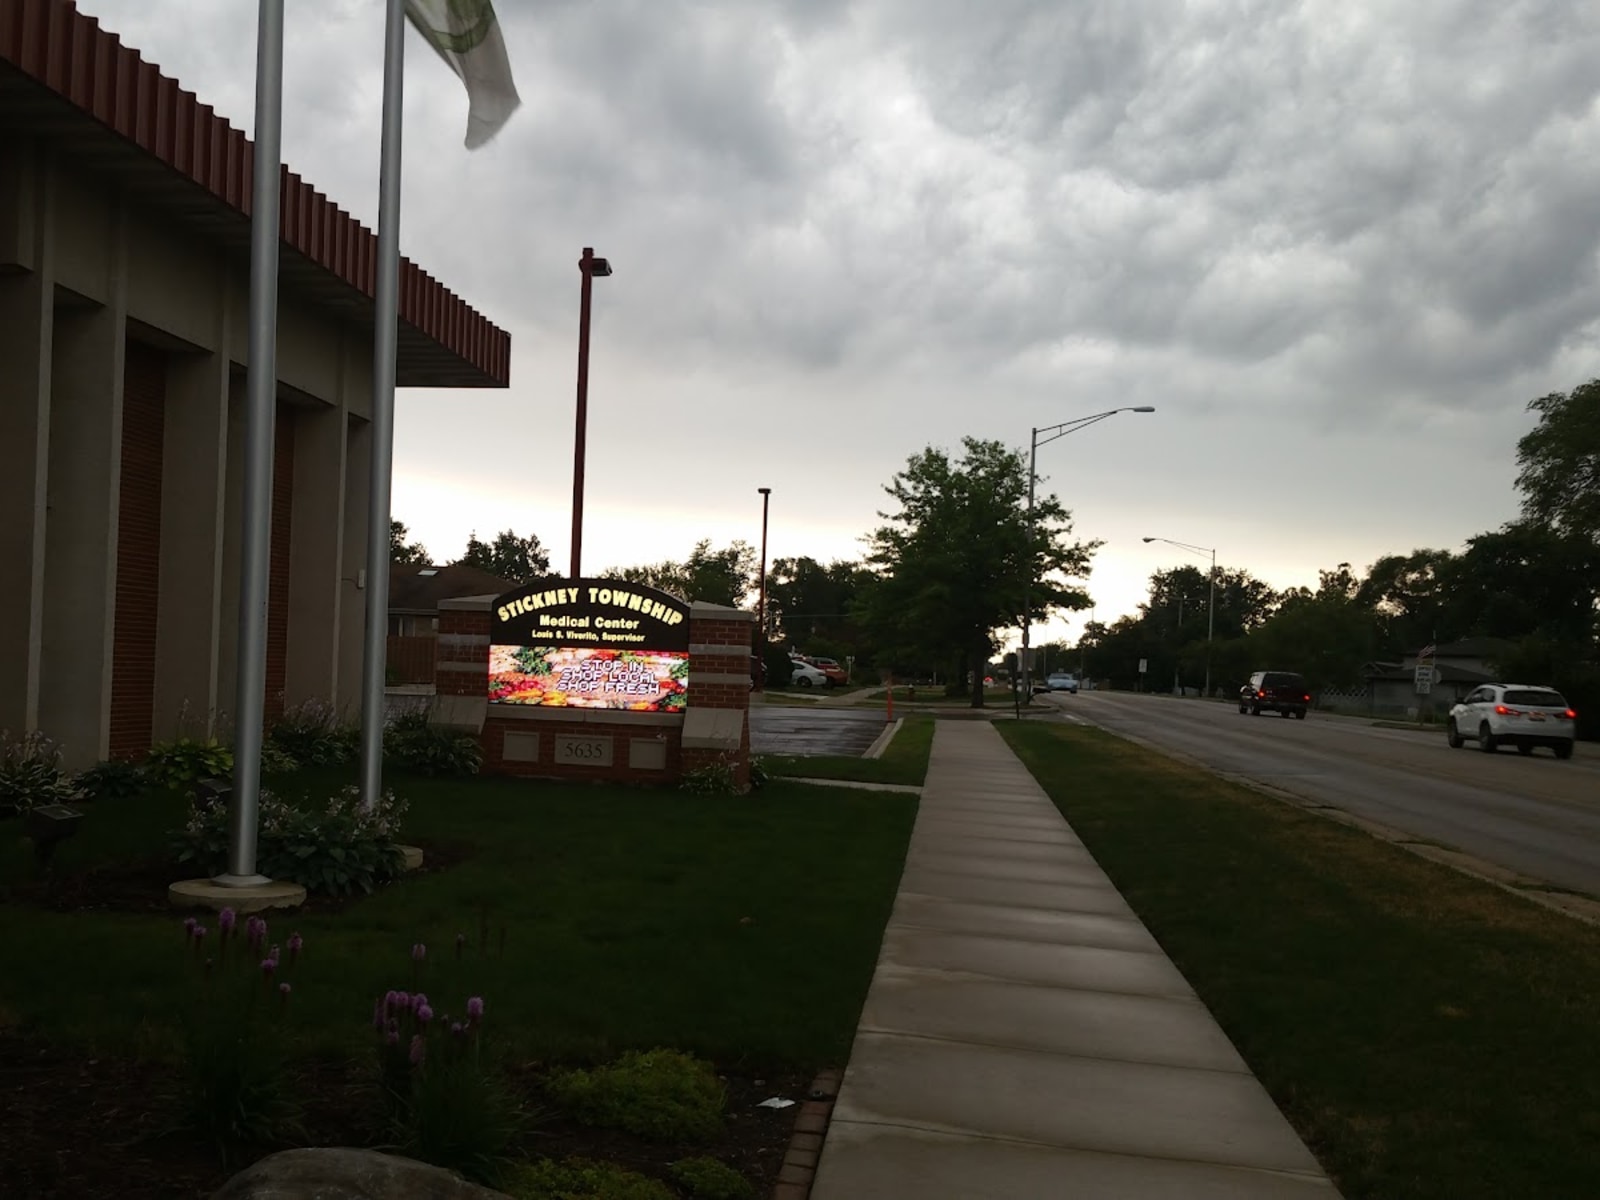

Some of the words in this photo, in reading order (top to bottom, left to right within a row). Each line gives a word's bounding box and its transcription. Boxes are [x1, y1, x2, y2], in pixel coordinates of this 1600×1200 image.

[497, 587, 579, 622] STICKNEY
[588, 587, 684, 627] TOWNSHIP
[539, 615, 590, 628] Medical
[594, 616, 640, 629] Center
[532, 629, 553, 639] Louis
[601, 632, 645, 643] Supervisor
[580, 659, 623, 672] STOP
[628, 661, 645, 673] IN
[560, 668, 603, 681] SHOP
[608, 671, 660, 684] LOCAL
[556, 680, 600, 693] SHOP
[604, 682, 661, 695] FRESH
[564, 742, 604, 760] 5635
